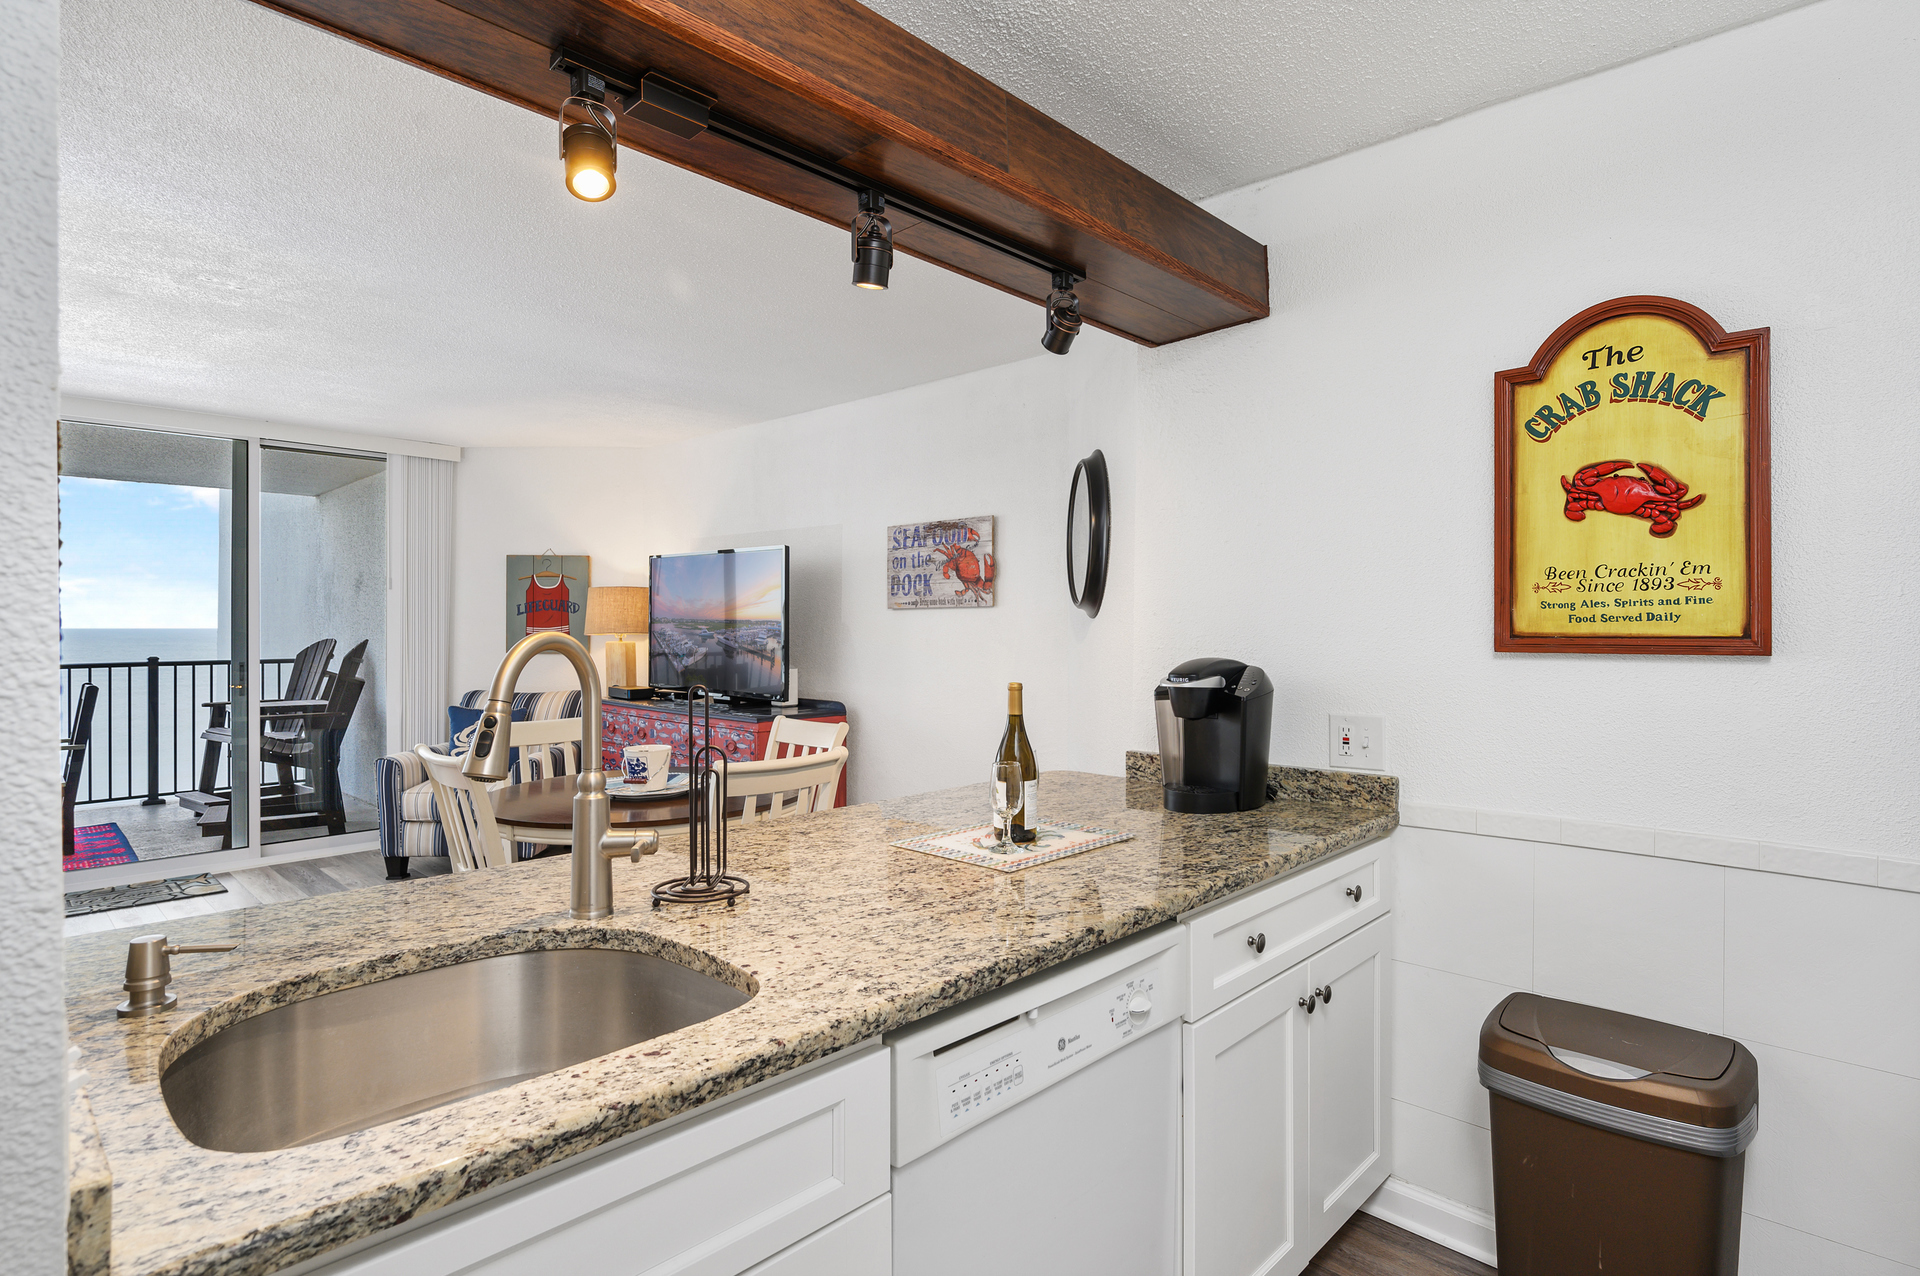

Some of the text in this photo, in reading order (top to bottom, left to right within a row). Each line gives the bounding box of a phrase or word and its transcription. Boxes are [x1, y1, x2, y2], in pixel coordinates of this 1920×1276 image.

[1582, 345, 1644, 370] The
[1524, 371, 1726, 443] CRAB SHACK
[892, 521, 968, 551] SEAFOOD
[892, 556, 906, 570] on
[911, 551, 932, 569] the
[1544, 560, 1712, 580] Been Crackin' Em
[891, 574, 933, 597] DOCK
[1576, 576, 1675, 593] Since 1893
[516, 599, 580, 616] LIFEGUARD
[1540, 595, 1714, 611] Strong Ales, Spirits and Fine
[1568, 612, 1682, 624] Food Served Daily
